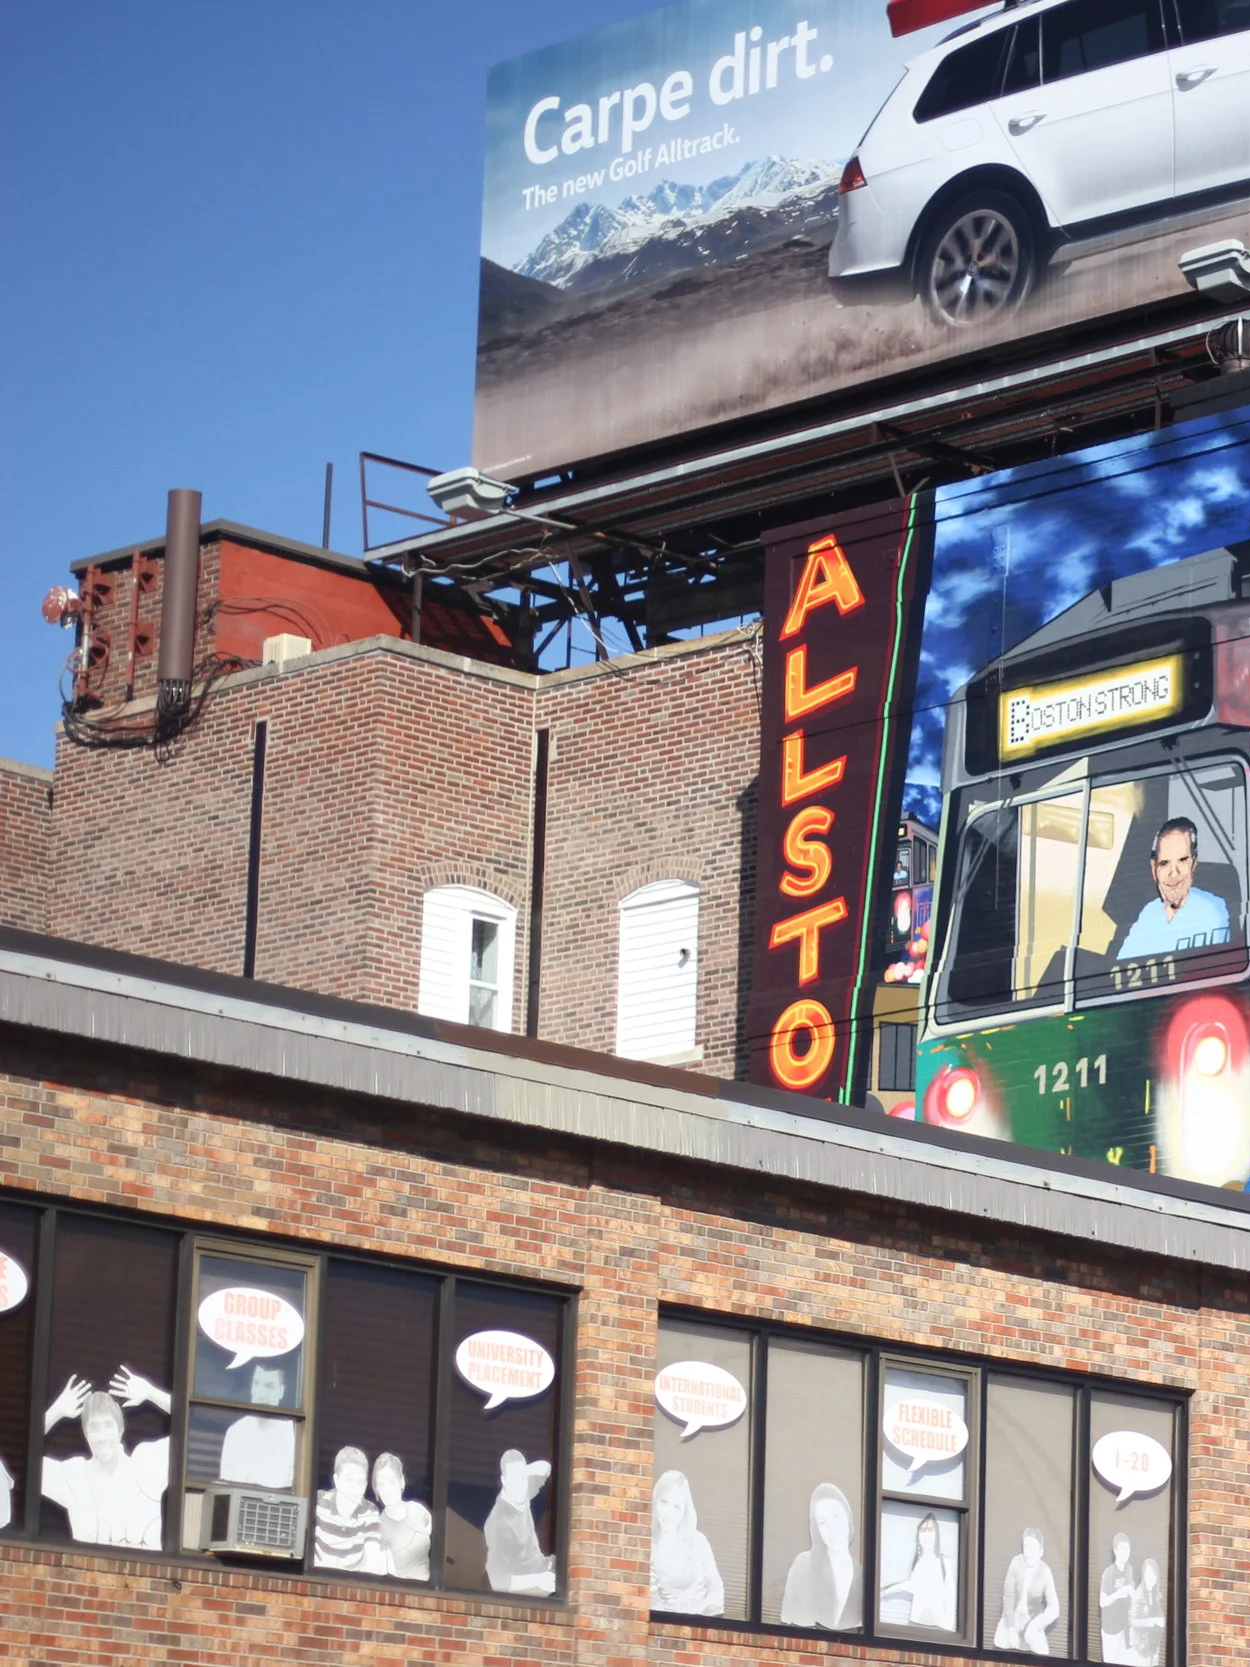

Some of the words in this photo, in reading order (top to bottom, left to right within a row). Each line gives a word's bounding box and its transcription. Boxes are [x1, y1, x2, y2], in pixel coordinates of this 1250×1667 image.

[523, 69, 694, 165] Carpe
[708, 20, 834, 106] dirt.
[522, 185, 558, 211] The
[562, 170, 605, 199] new
[610, 153, 654, 184] Golf
[654, 122, 741, 168] Alltrack.
[1011, 694, 1092, 743] BOSTON
[1094, 675, 1169, 715] STRONG
[768, 533, 866, 1101] ALLSTO
[1110, 955, 1176, 990] 1211
[1034, 1054, 1107, 1095] 1211
[224, 1292, 281, 1320] GROUP
[214, 1318, 287, 1349] CLASSES
[468, 1340, 543, 1368] UNIVERSITY
[468, 1362, 541, 1389] PLACEMENT
[659, 1375, 740, 1402] INTERNATIONAL
[672, 1396, 727, 1419] STUDENTS
[899, 1404, 952, 1428] FLEXIBLE
[893, 1426, 956, 1452] SCHEDULE
